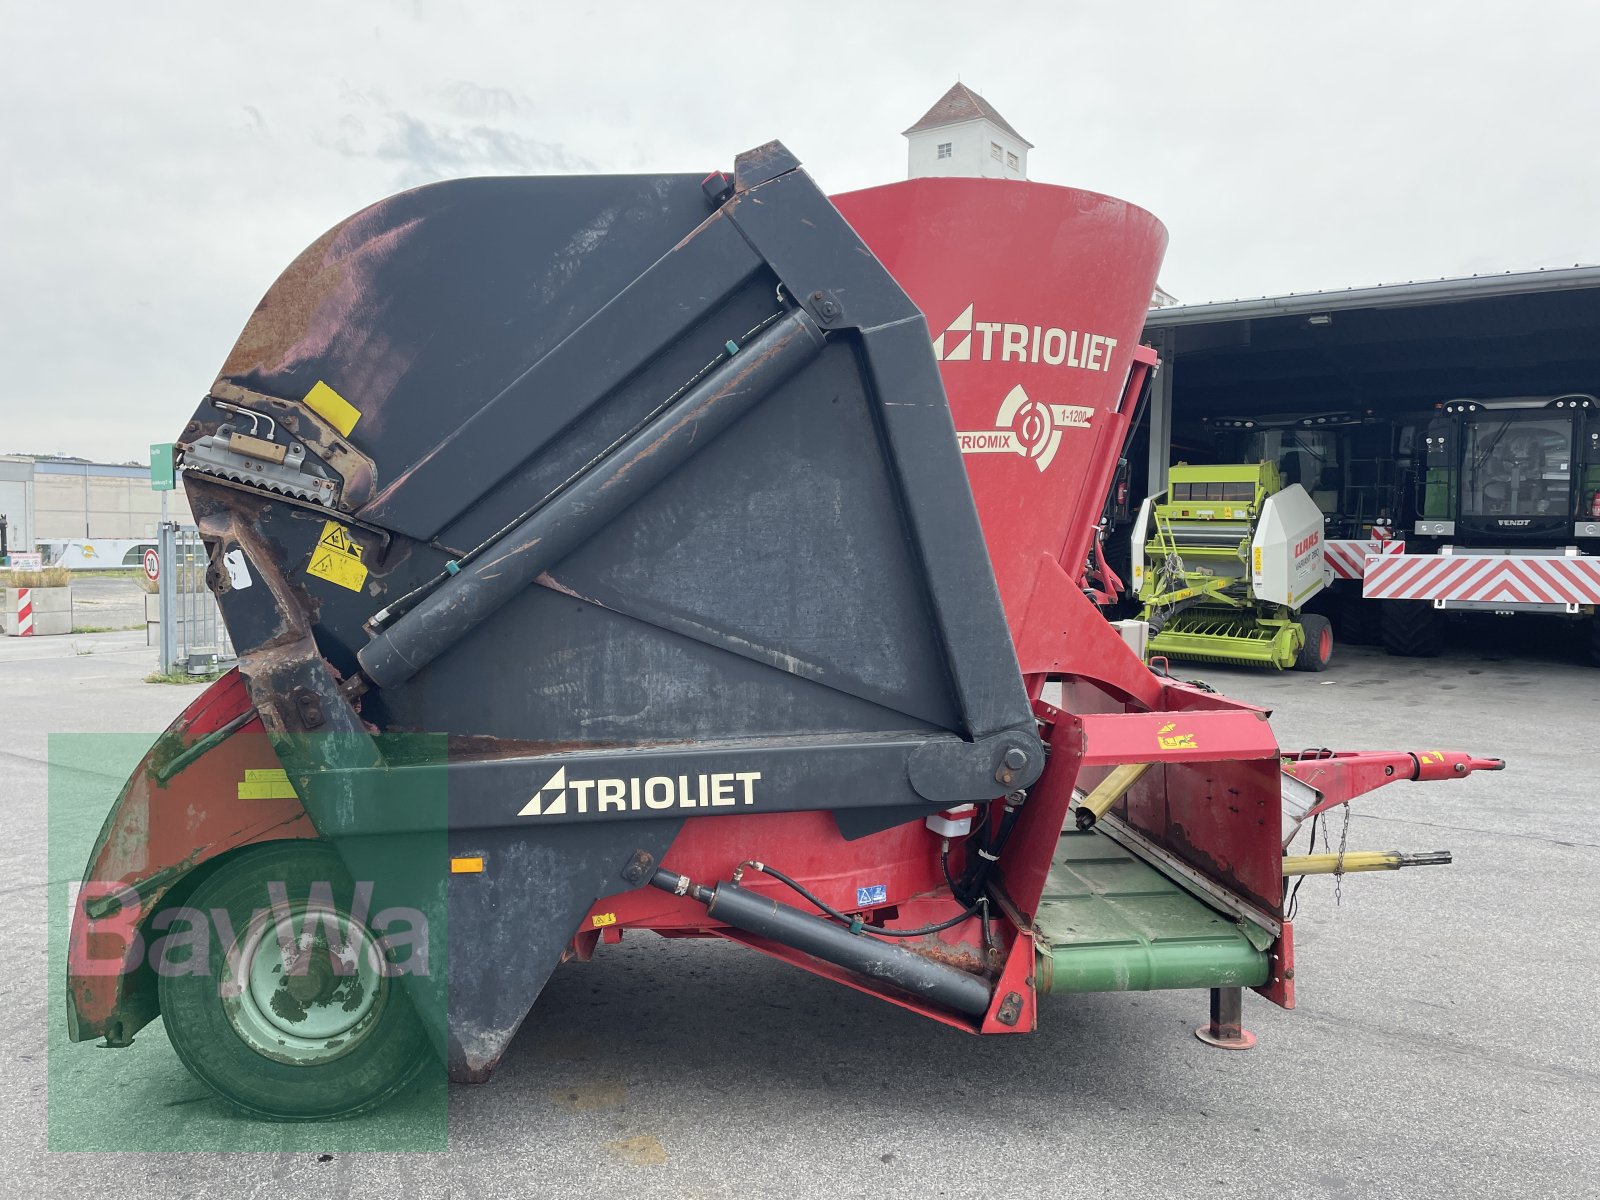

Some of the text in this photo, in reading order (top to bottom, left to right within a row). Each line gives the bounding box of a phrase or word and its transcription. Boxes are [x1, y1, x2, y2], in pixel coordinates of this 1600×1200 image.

[975, 322, 1117, 371] TRIOLIET
[1294, 531, 1319, 559] CLAAS
[569, 771, 761, 813] TRIOLIET
